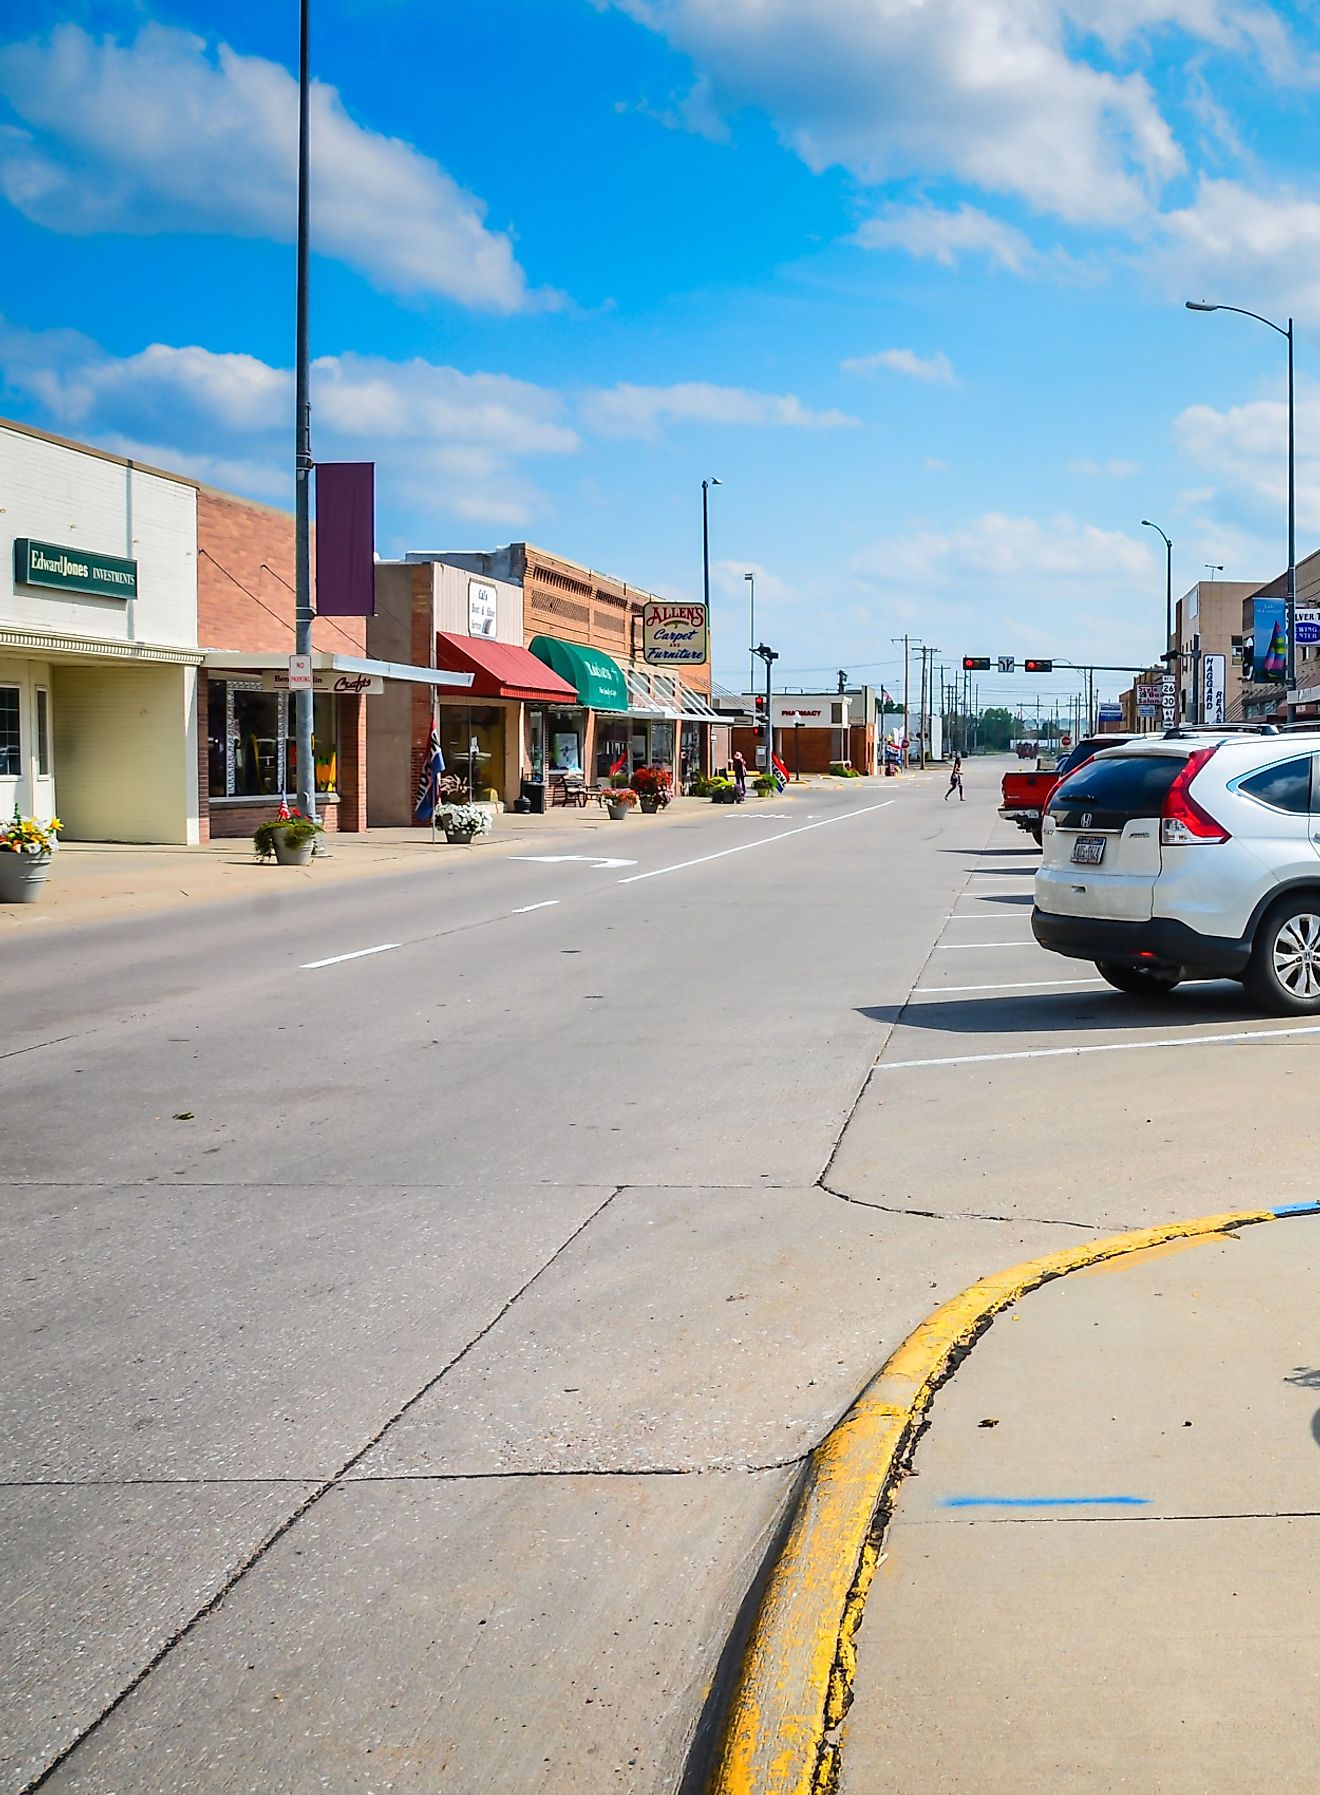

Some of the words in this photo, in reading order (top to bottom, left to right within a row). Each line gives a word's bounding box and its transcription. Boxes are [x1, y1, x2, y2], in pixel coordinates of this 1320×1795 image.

[92, 567, 135, 586] INVESTMENTS
[646, 606, 704, 627] ALLEN'S
[653, 628, 699, 643] Carpet
[647, 647, 704, 659] Furniture
[290, 675, 311, 683] PARKING
[1206, 658, 1214, 710] HAGGARD
